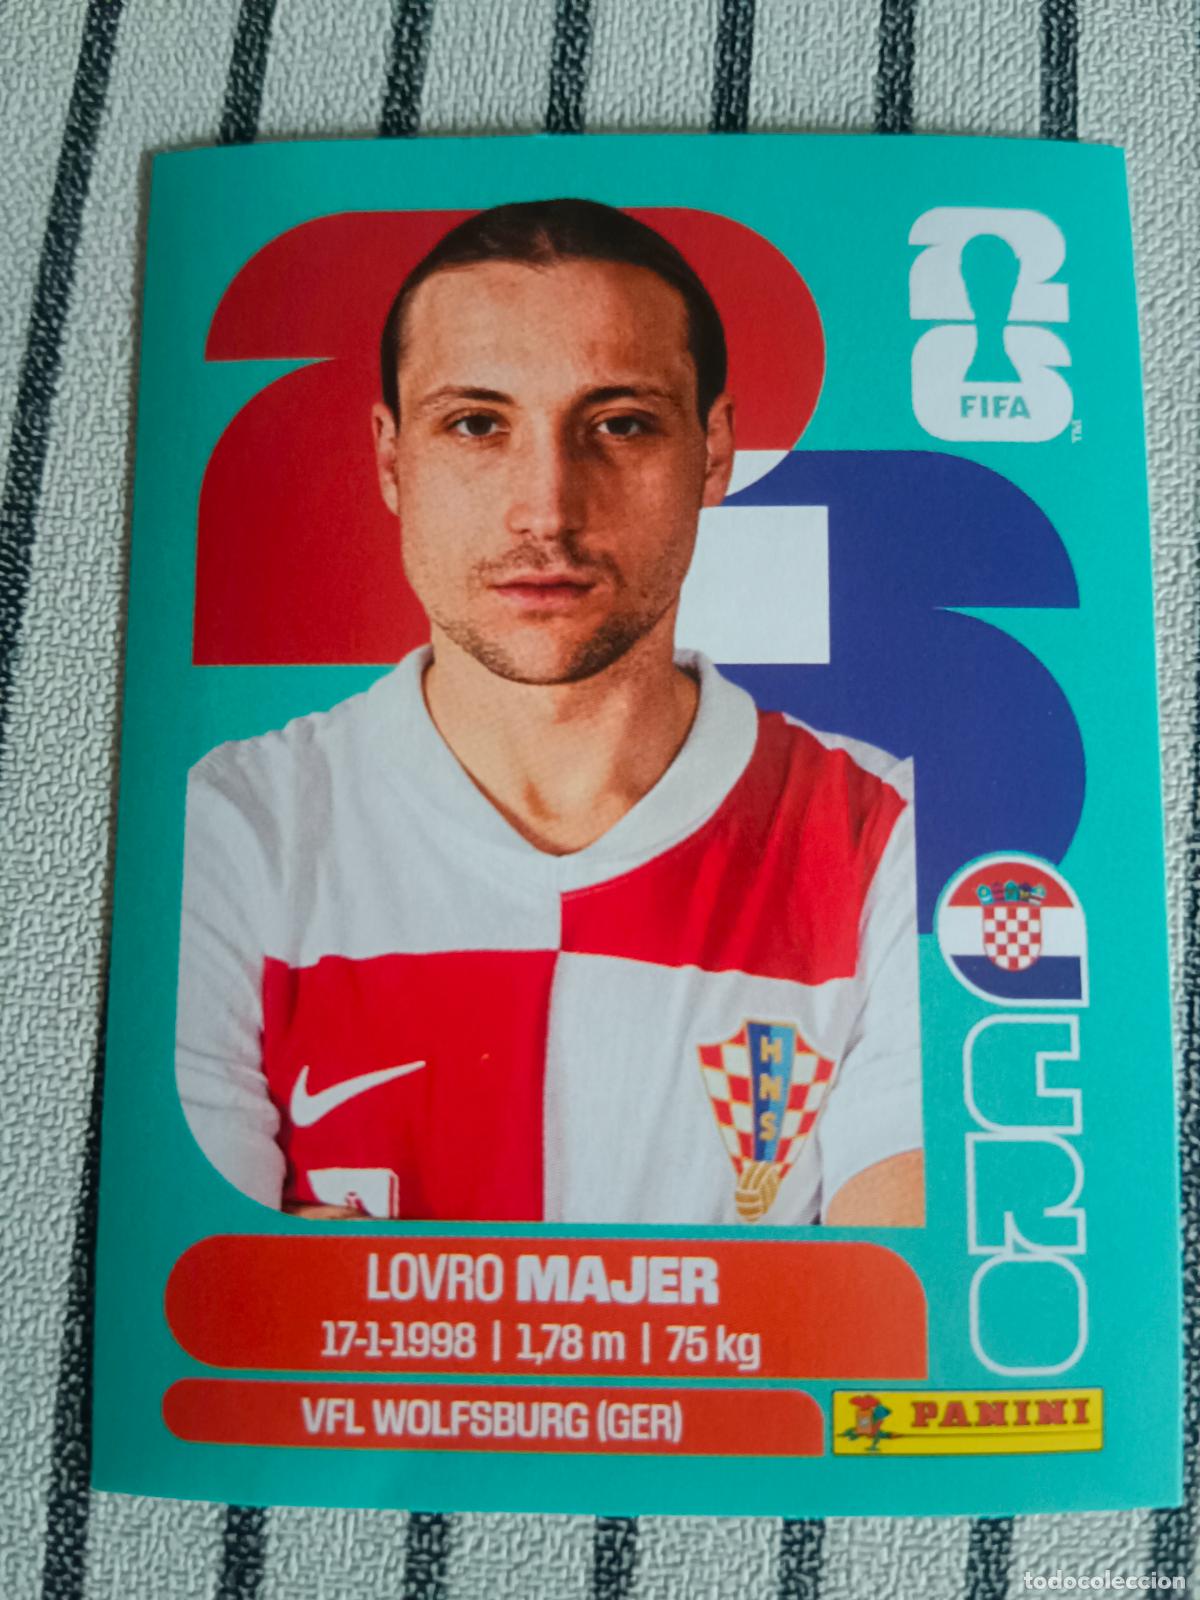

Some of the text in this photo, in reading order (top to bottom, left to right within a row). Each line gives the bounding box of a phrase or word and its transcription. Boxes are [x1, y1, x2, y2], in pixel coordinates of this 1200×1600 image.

[960, 395, 1031, 419] FIFA
[367, 1253, 720, 1304] LOVRO MAJER
[321, 1320, 476, 1358] 17-1-1998
[516, 1323, 583, 1365] 1,78
[592, 1330, 625, 1361] m
[666, 1326, 708, 1362] 75
[716, 1325, 761, 1371] kg
[302, 1398, 682, 1444] VFL WOLFSBURG (GER)
[911, 1398, 1090, 1428] PANINI
